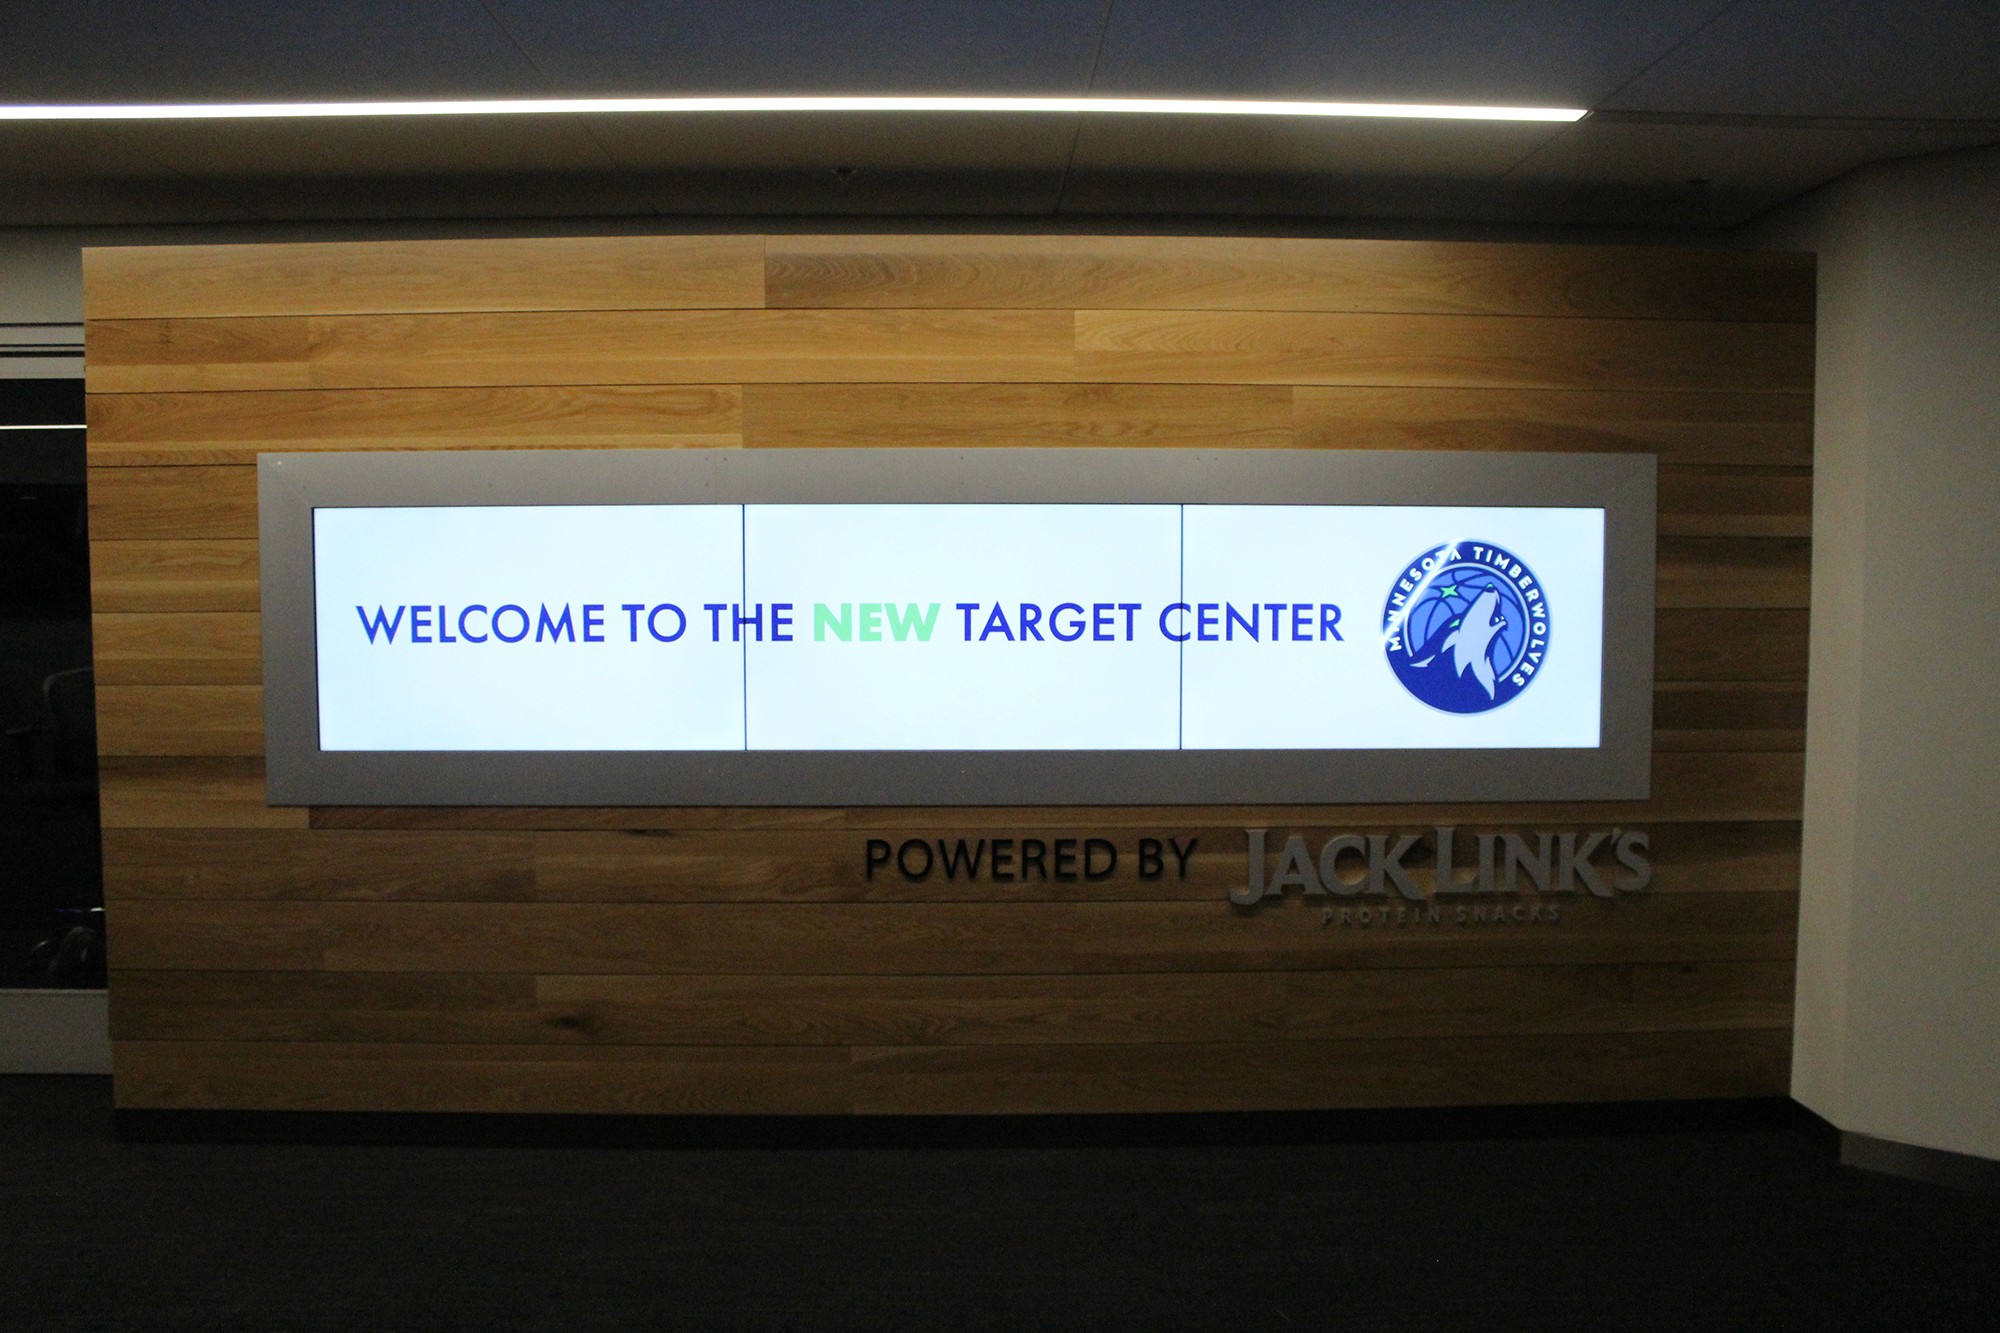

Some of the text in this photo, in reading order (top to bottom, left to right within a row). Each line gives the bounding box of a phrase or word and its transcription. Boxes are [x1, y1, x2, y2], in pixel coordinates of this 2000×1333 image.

[355, 602, 1345, 645] WELCOME TO THE NEW TARGET CENTER
[1472, 546, 1547, 687] TIMBERWOLVES
[866, 826, 1652, 905] POWERED BY JACK LINK'S
[1321, 903, 1560, 924] PROTEIN SNACKS
